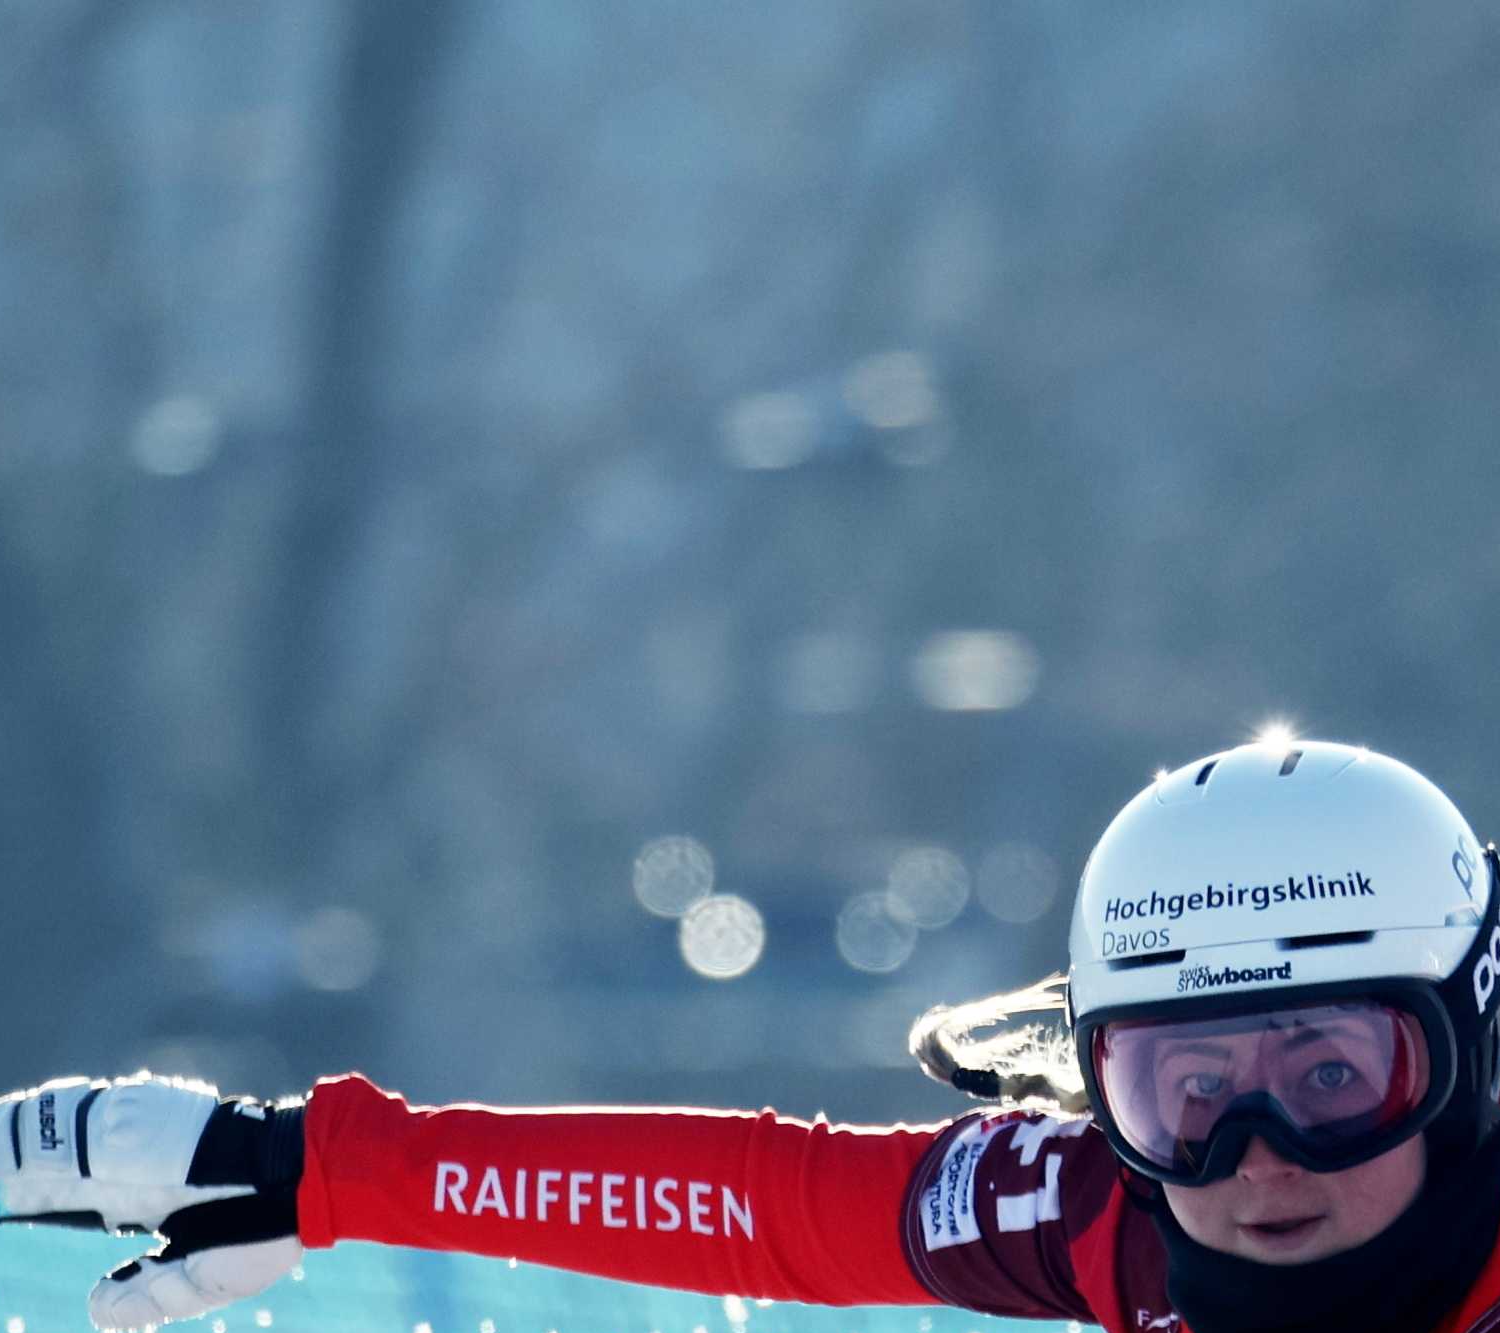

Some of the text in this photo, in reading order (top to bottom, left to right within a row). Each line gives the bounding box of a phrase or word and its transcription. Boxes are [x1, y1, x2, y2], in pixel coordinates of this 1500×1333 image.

[1104, 871, 1375, 923] Hochgebirgsklinik
[1102, 927, 1171, 957] Davos
[1180, 963, 1211, 981] swiss
[434, 1161, 754, 1242] RAIFFEISEN
